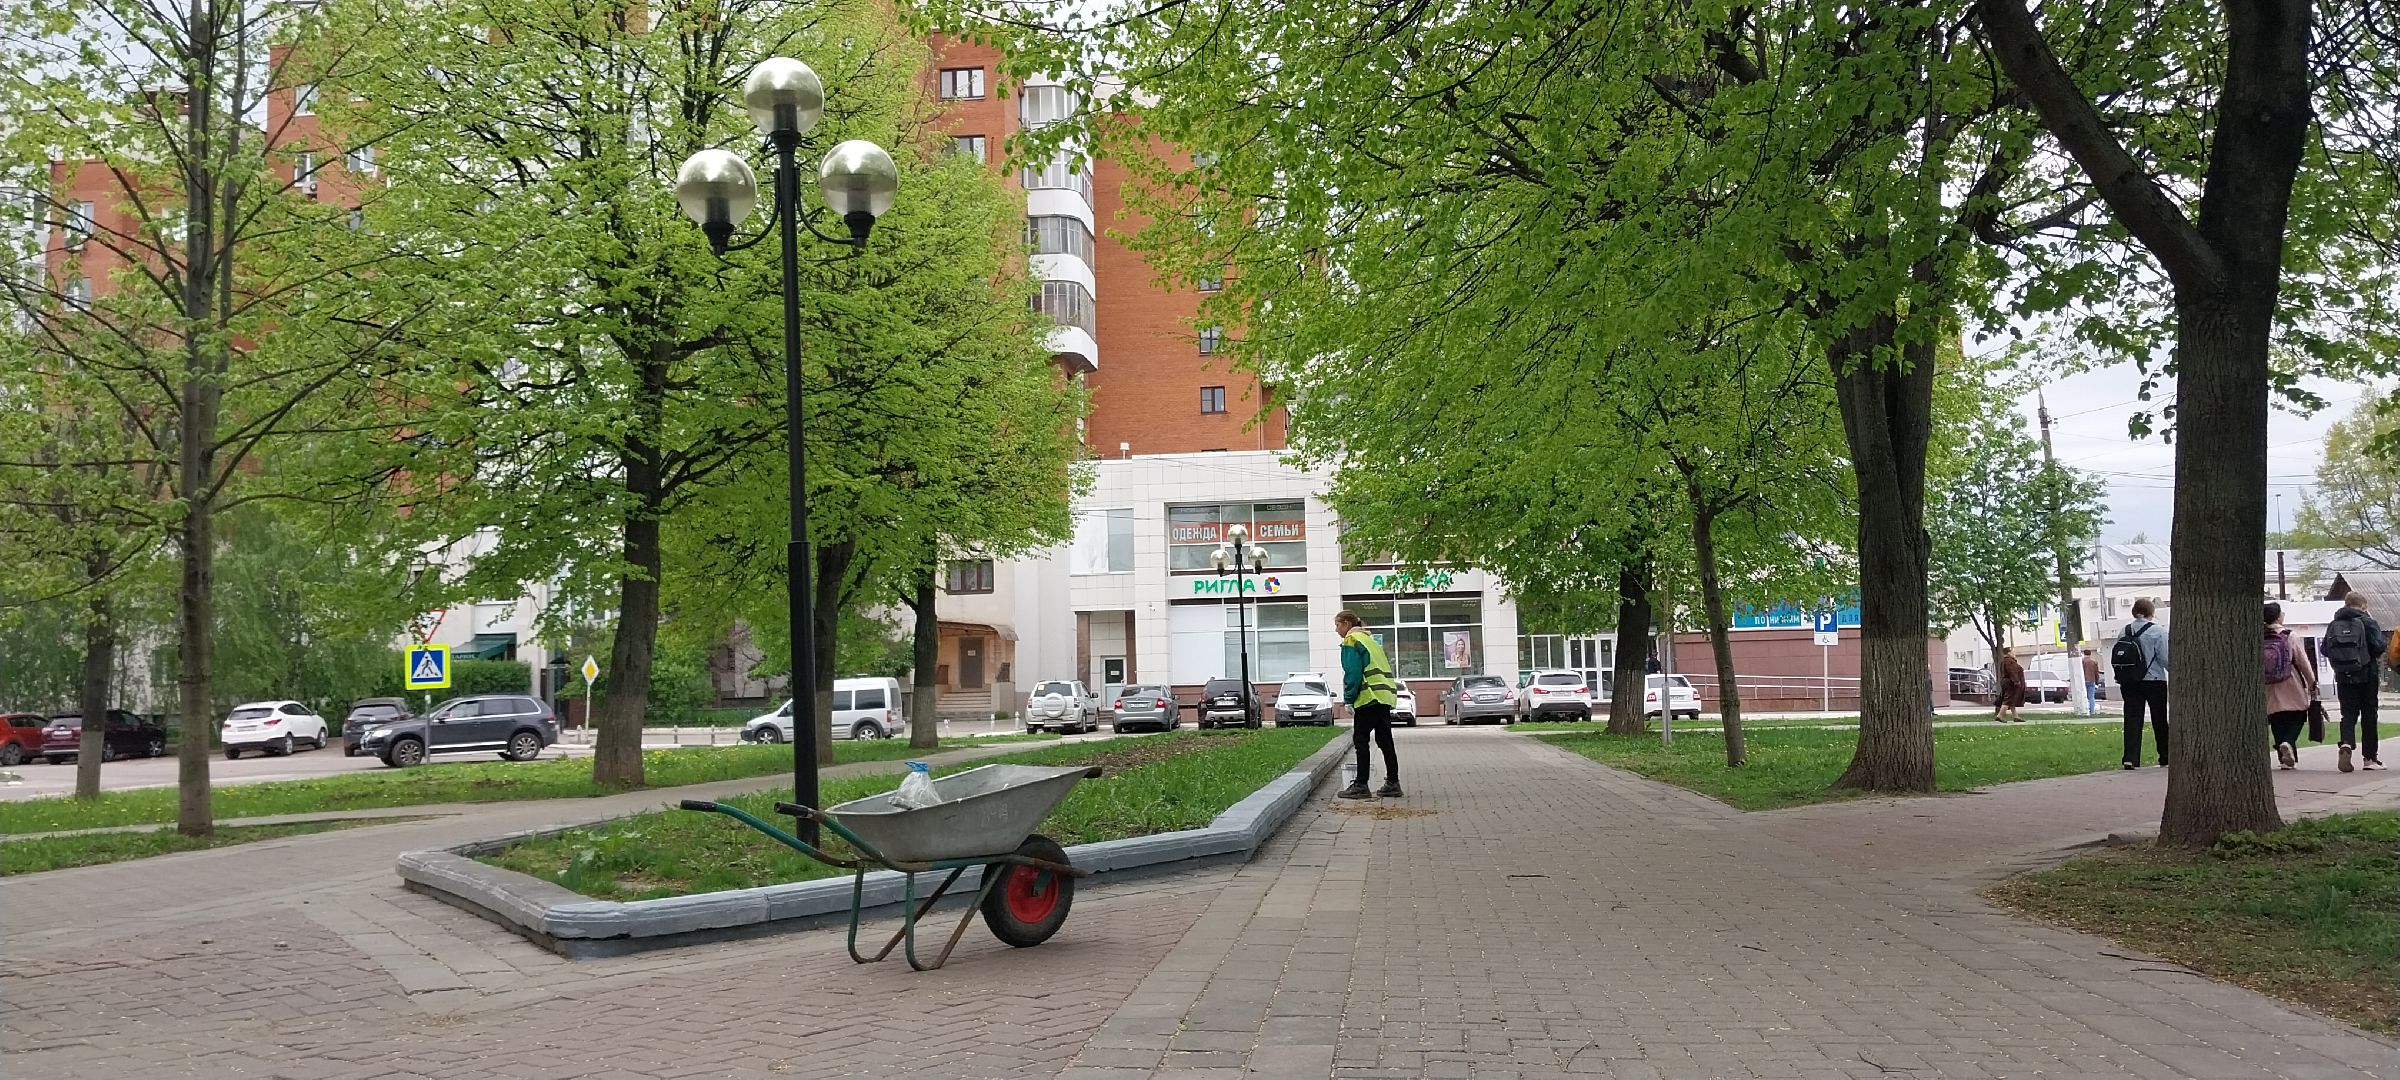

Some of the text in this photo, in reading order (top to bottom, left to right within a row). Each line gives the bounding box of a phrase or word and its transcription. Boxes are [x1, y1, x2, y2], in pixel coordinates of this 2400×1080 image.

[1172, 523, 1299, 541] ОДЕЖДА СЕМЬИ
[1194, 571, 1454, 594] РИГЛА АПТКА
